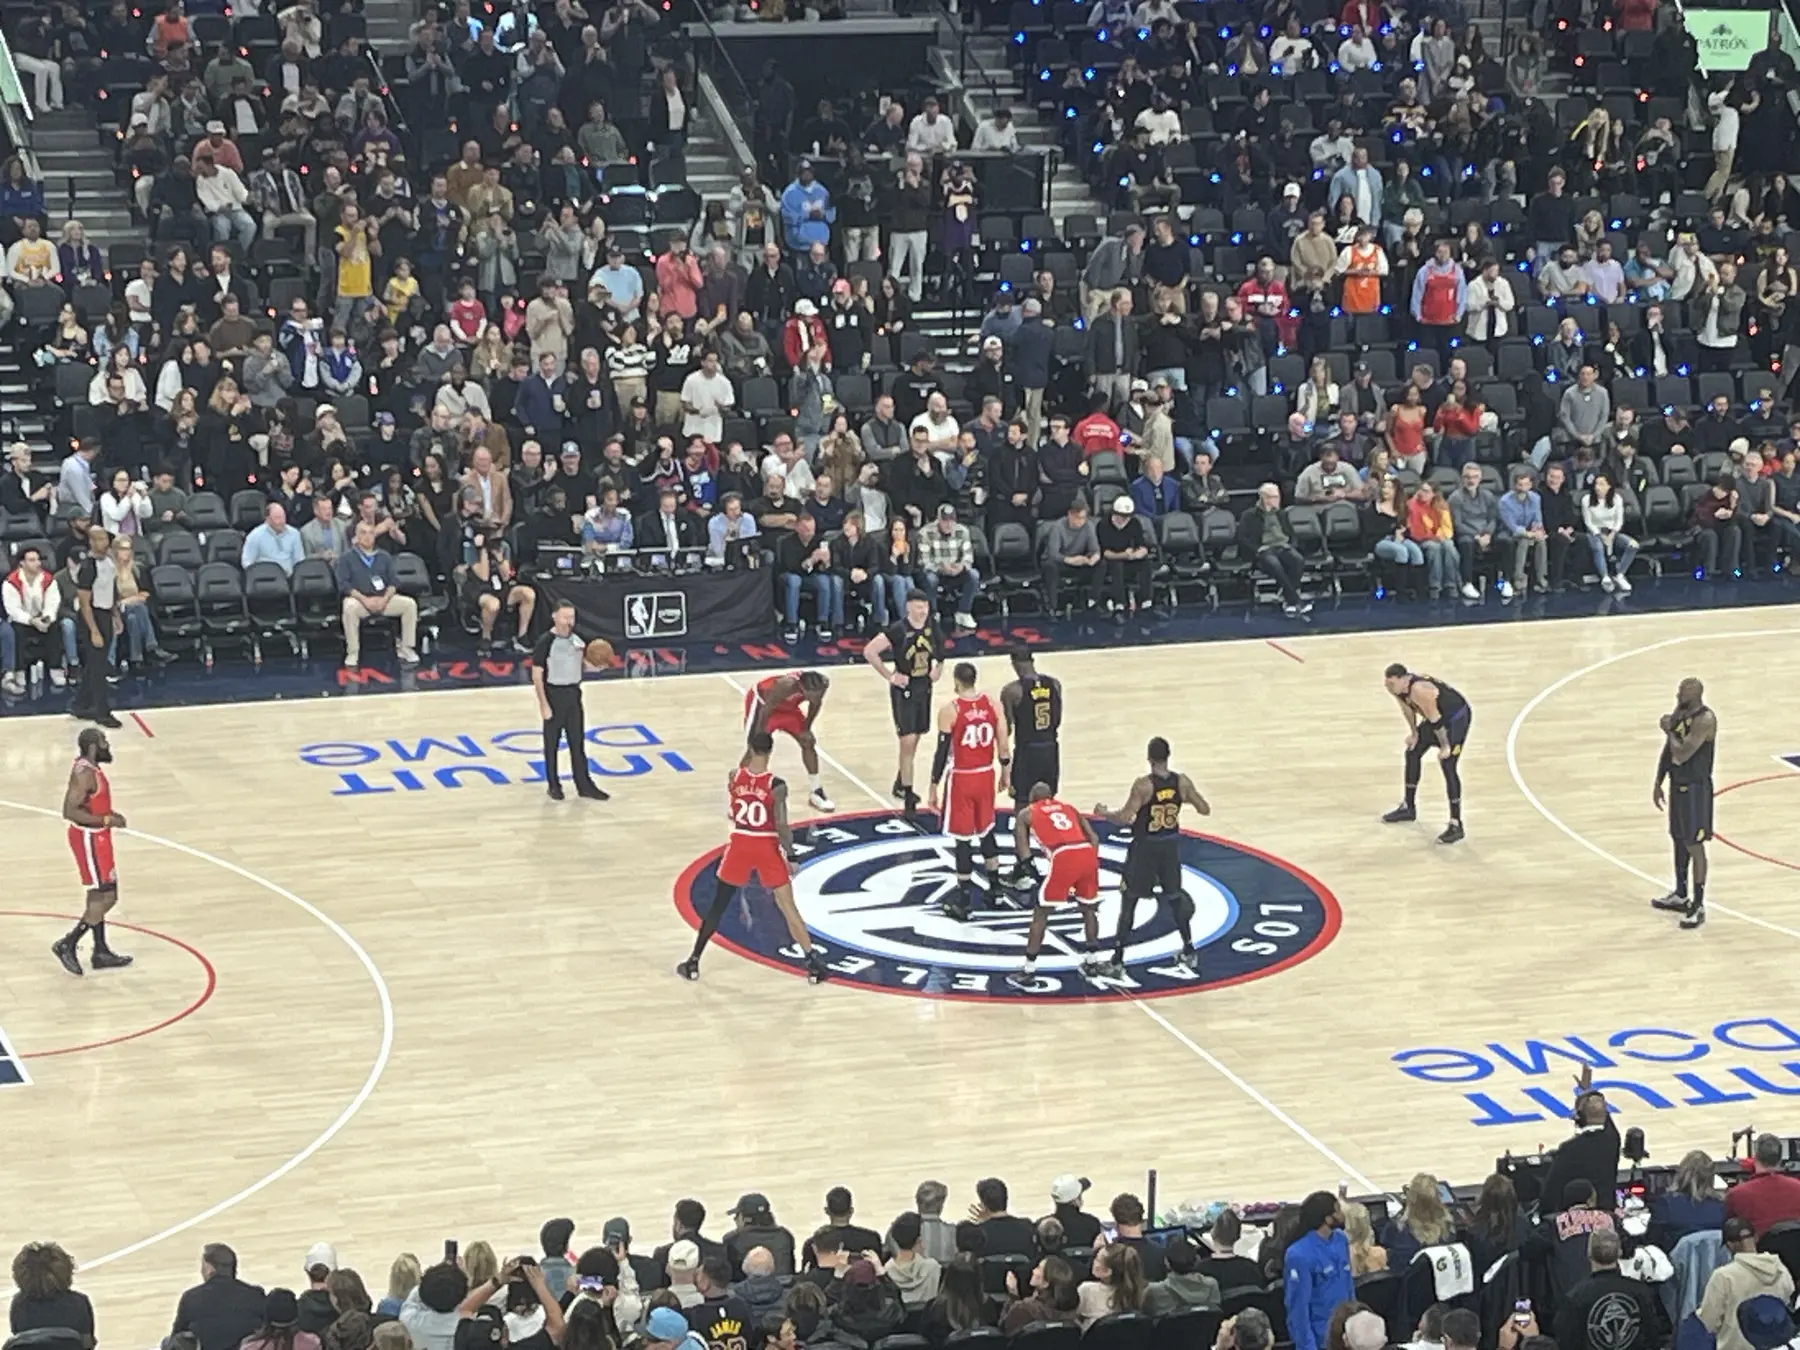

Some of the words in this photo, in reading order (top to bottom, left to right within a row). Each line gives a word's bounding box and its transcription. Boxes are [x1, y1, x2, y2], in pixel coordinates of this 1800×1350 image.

[1034, 701, 1051, 731] 5
[961, 721, 994, 750] 40
[735, 798, 768, 827] 20
[1049, 811, 1074, 831] 8
[1147, 803, 1179, 832] 36
[1231, 903, 1303, 957] LOS
